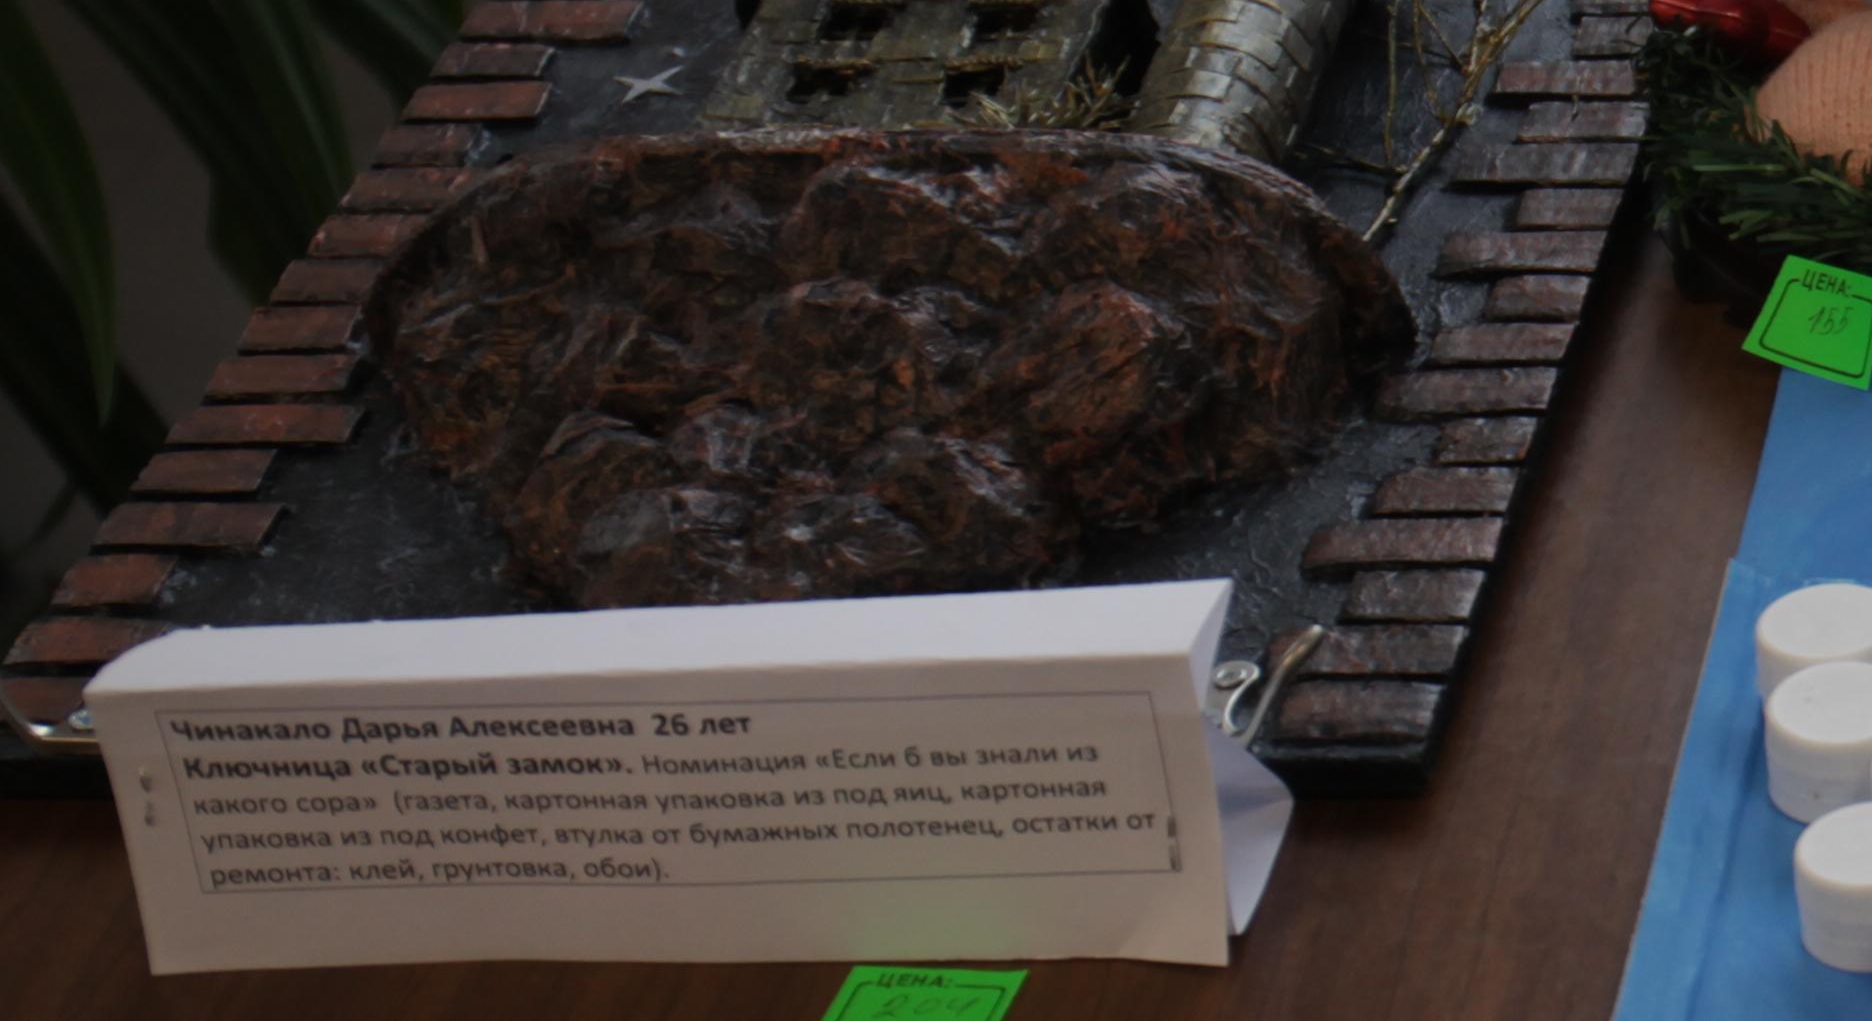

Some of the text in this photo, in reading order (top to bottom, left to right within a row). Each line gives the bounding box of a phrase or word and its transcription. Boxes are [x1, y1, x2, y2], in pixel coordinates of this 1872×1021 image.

[1801, 269, 1851, 296] ЦЕНА:
[171, 713, 751, 745] Чинакало Дарья Алексеевна 26 лет
[183, 745, 1098, 781] Ключница «Старый замок». Номинация «Если б вы знали из
[193, 780, 1106, 816] какого сора» (газета, картонная упаковка из под яиц, картонная
[200, 812, 1156, 853] упаковка из под конфет, втулка от бумажных полотенец, остатки от
[210, 857, 669, 889] ремонта: клей, грунтовка, обои).
[876, 973, 953, 989] ЦЕНА:
